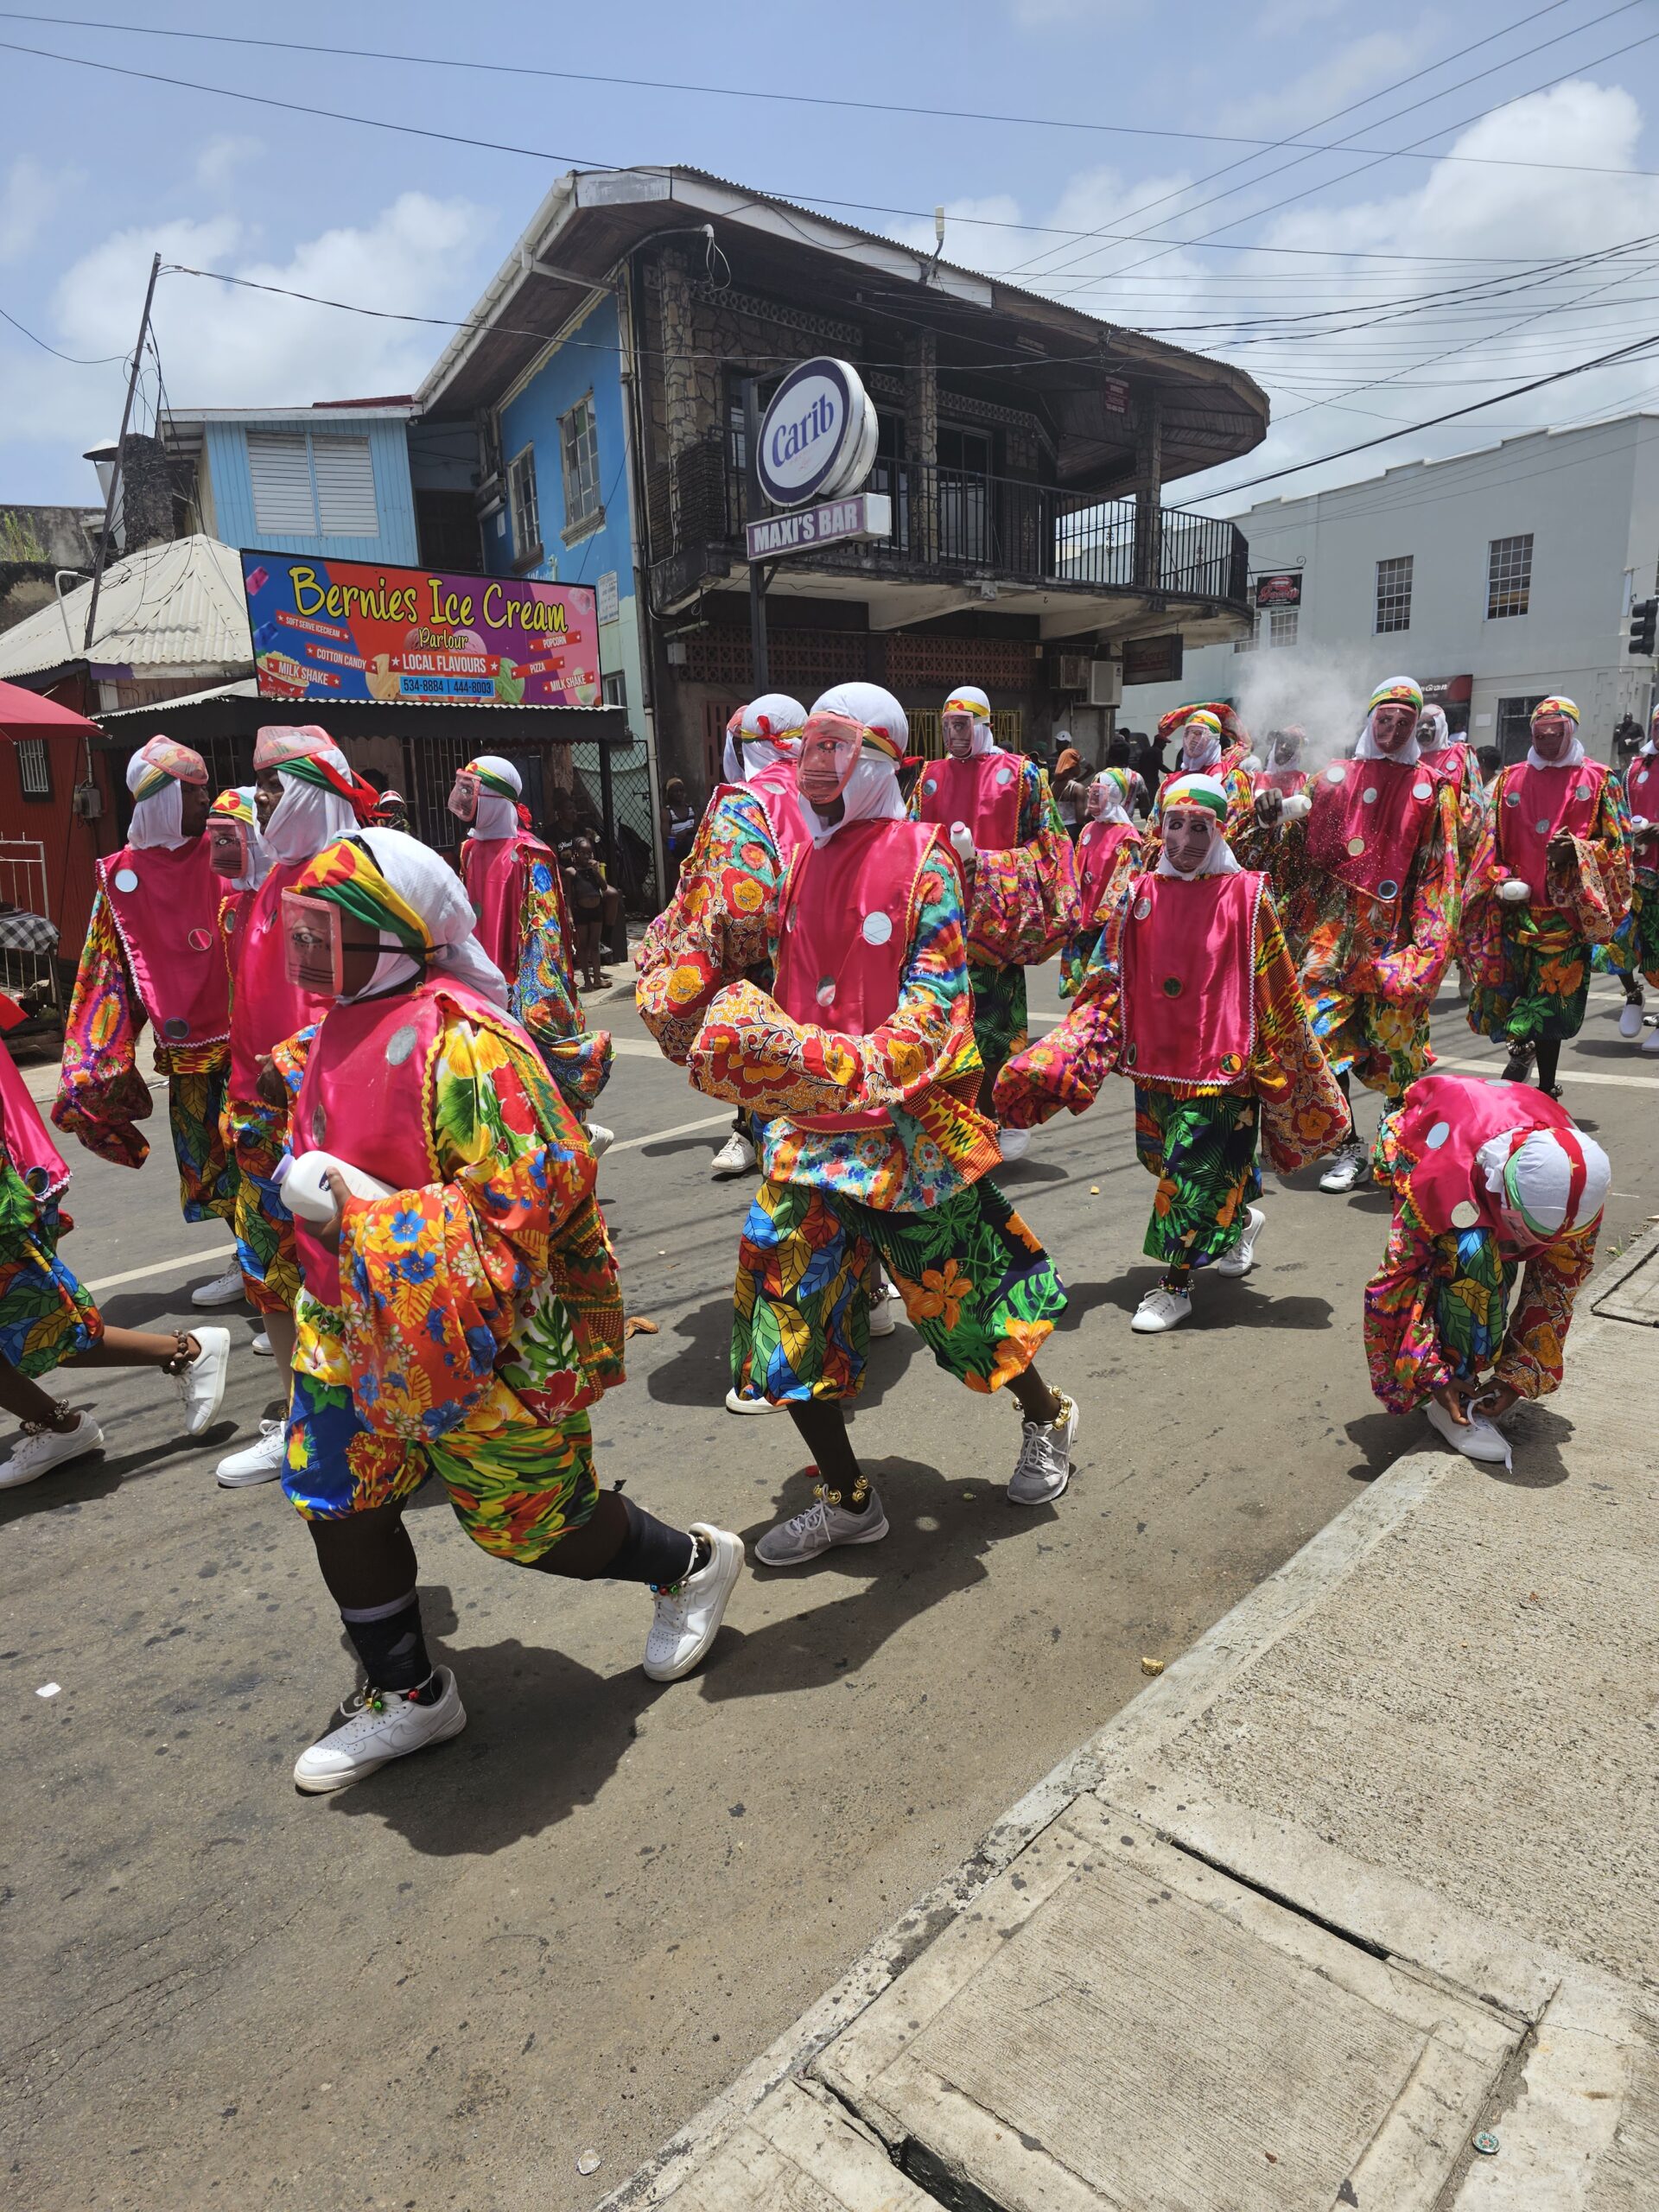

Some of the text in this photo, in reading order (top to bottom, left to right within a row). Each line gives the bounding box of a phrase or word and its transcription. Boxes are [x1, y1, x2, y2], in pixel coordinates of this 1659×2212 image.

[772, 392, 835, 468] Carib
[753, 503, 857, 553] MAXI'S BAR
[288, 566, 418, 624] Bernies
[428, 578, 475, 626] Ice
[483, 582, 569, 633] Cream
[286, 616, 340, 638] SOFT SERVE ICECREAM
[418, 626, 468, 650] Parlour
[543, 635, 567, 649] POPCORN
[316, 648, 367, 670] COTTON CANDY
[402, 653, 486, 673] LOCAL FLAVOURS
[530, 662, 546, 674] PIZZA
[278, 661, 329, 686] MILK SHAKE
[550, 674, 587, 692] MILK SHAKE
[404, 679, 491, 694] 534-8884 444-8003
